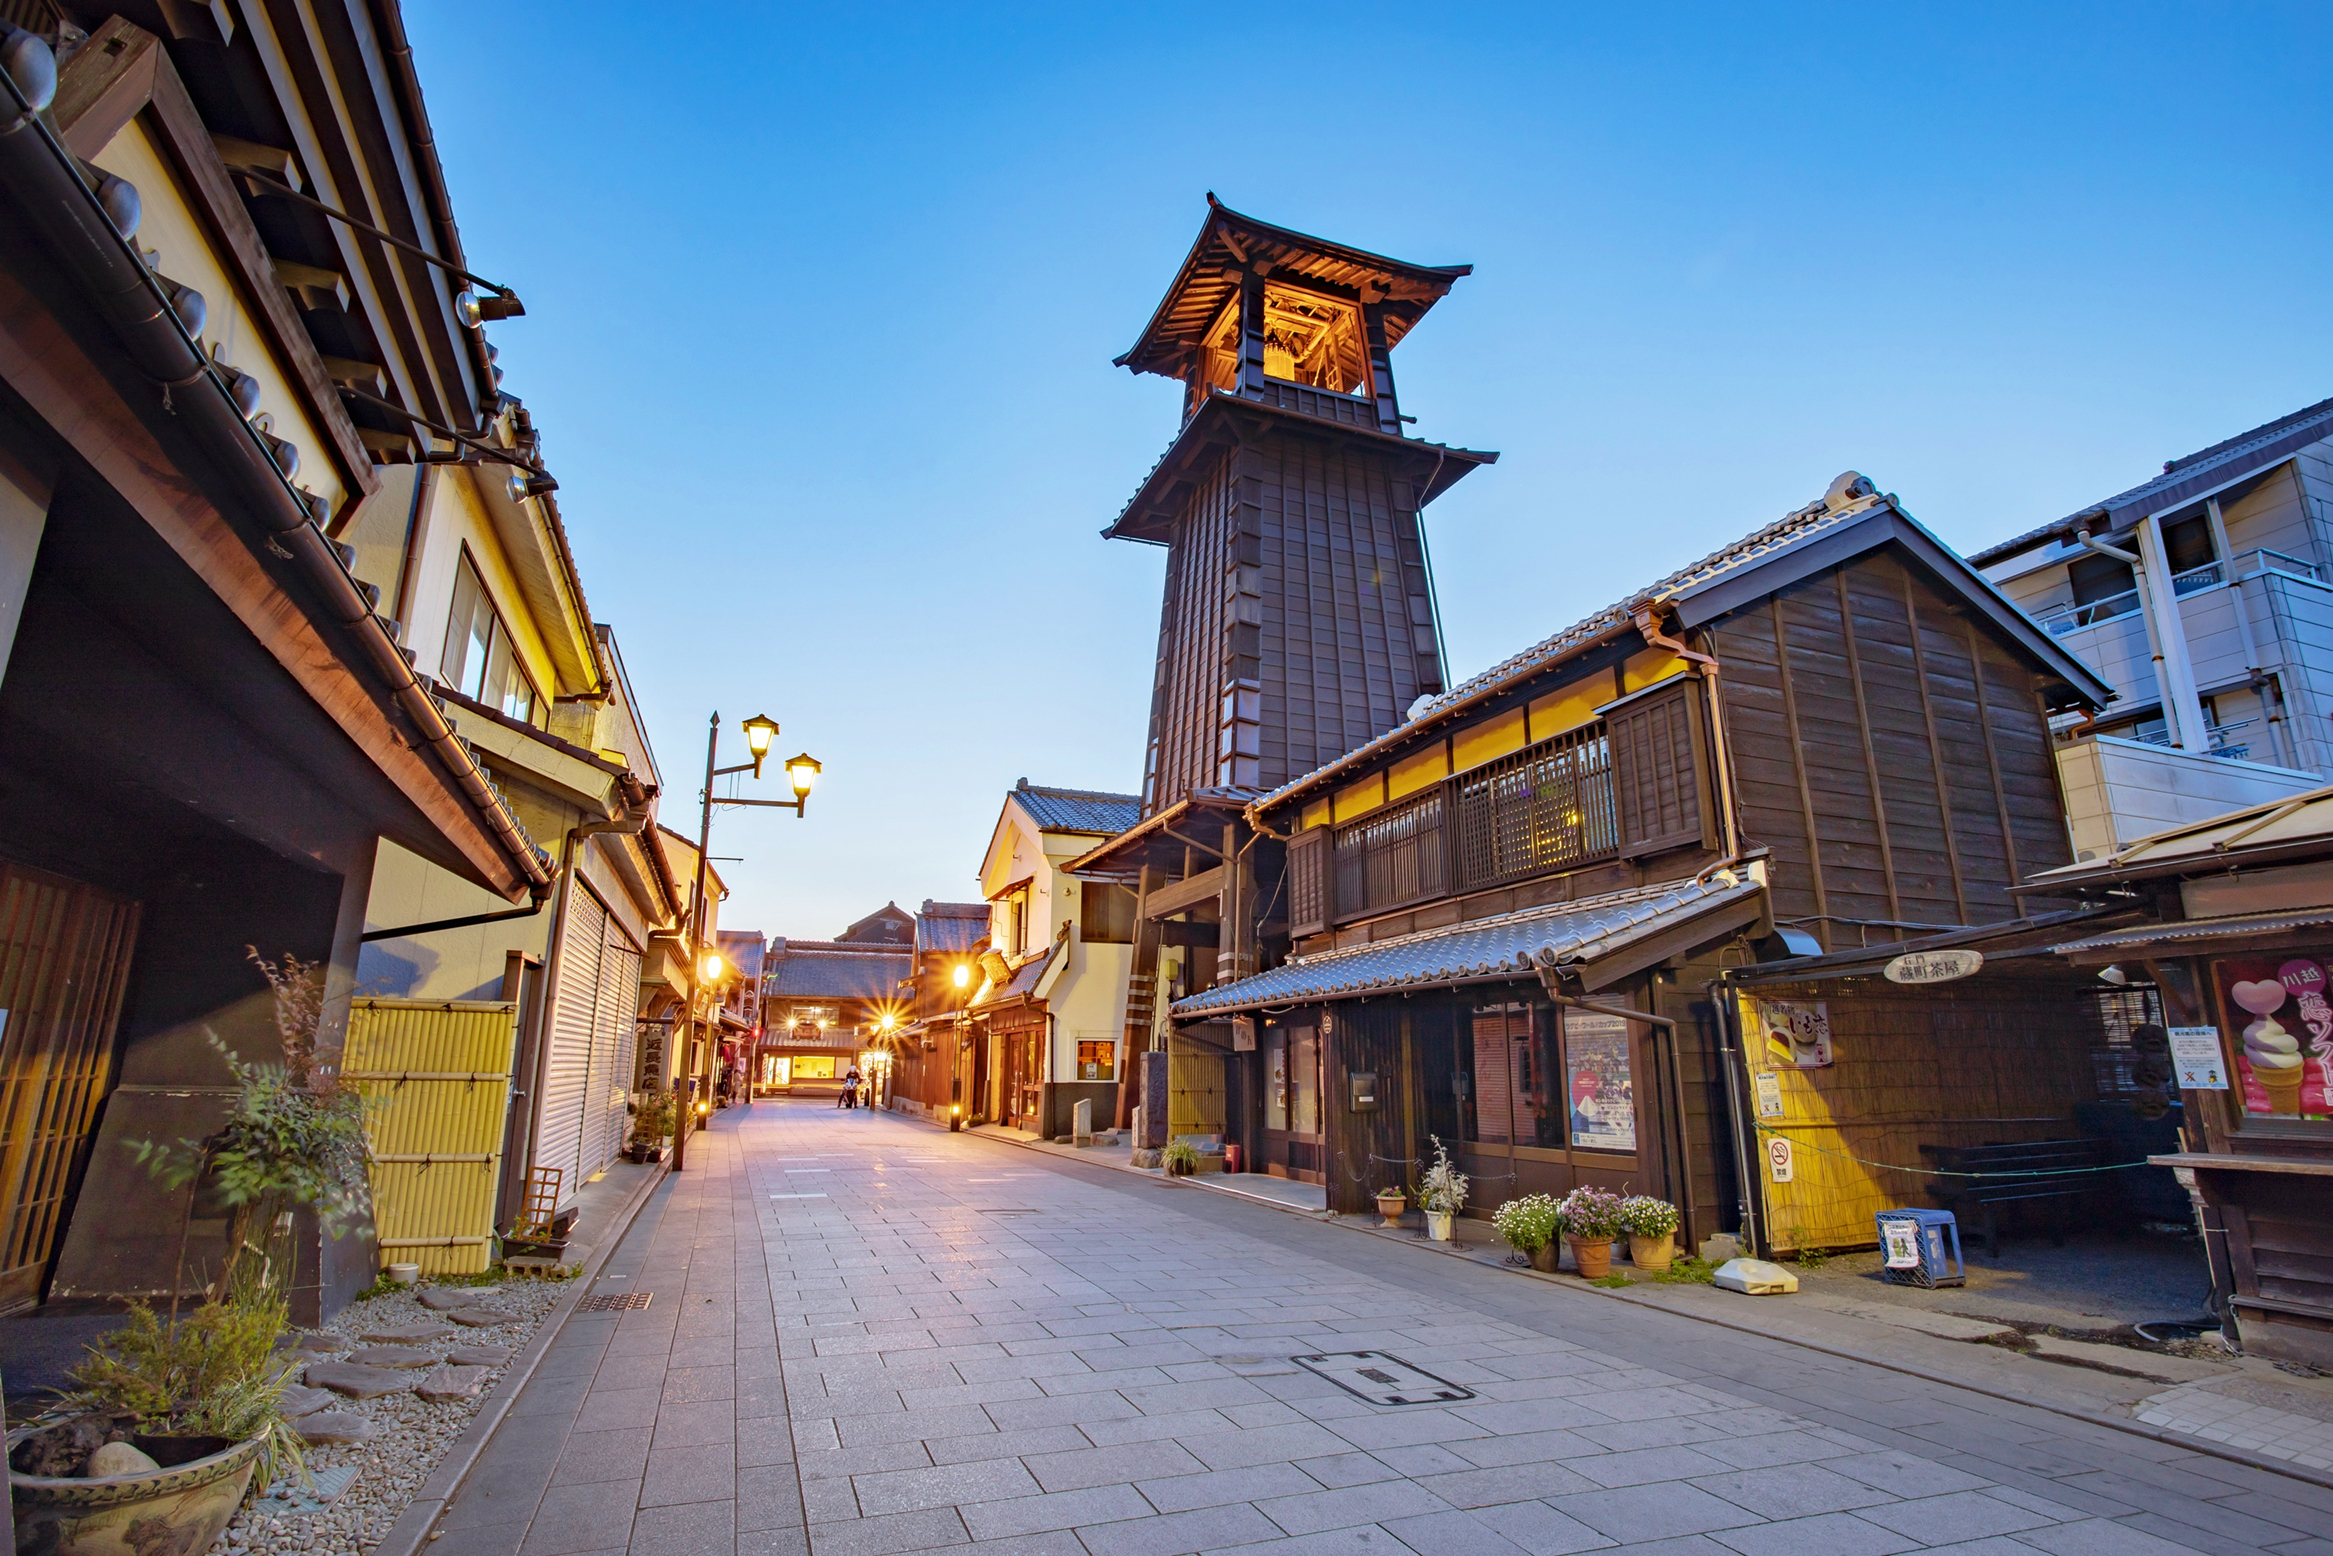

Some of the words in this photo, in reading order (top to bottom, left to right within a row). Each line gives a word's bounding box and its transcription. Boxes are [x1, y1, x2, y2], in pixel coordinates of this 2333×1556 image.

[1899, 960, 1961, 982] 蔵町茶屋
[2282, 966, 2322, 988] 川越
[1789, 1014, 1829, 1035] いも恋
[2298, 991, 2333, 1085] 恋ソフト
